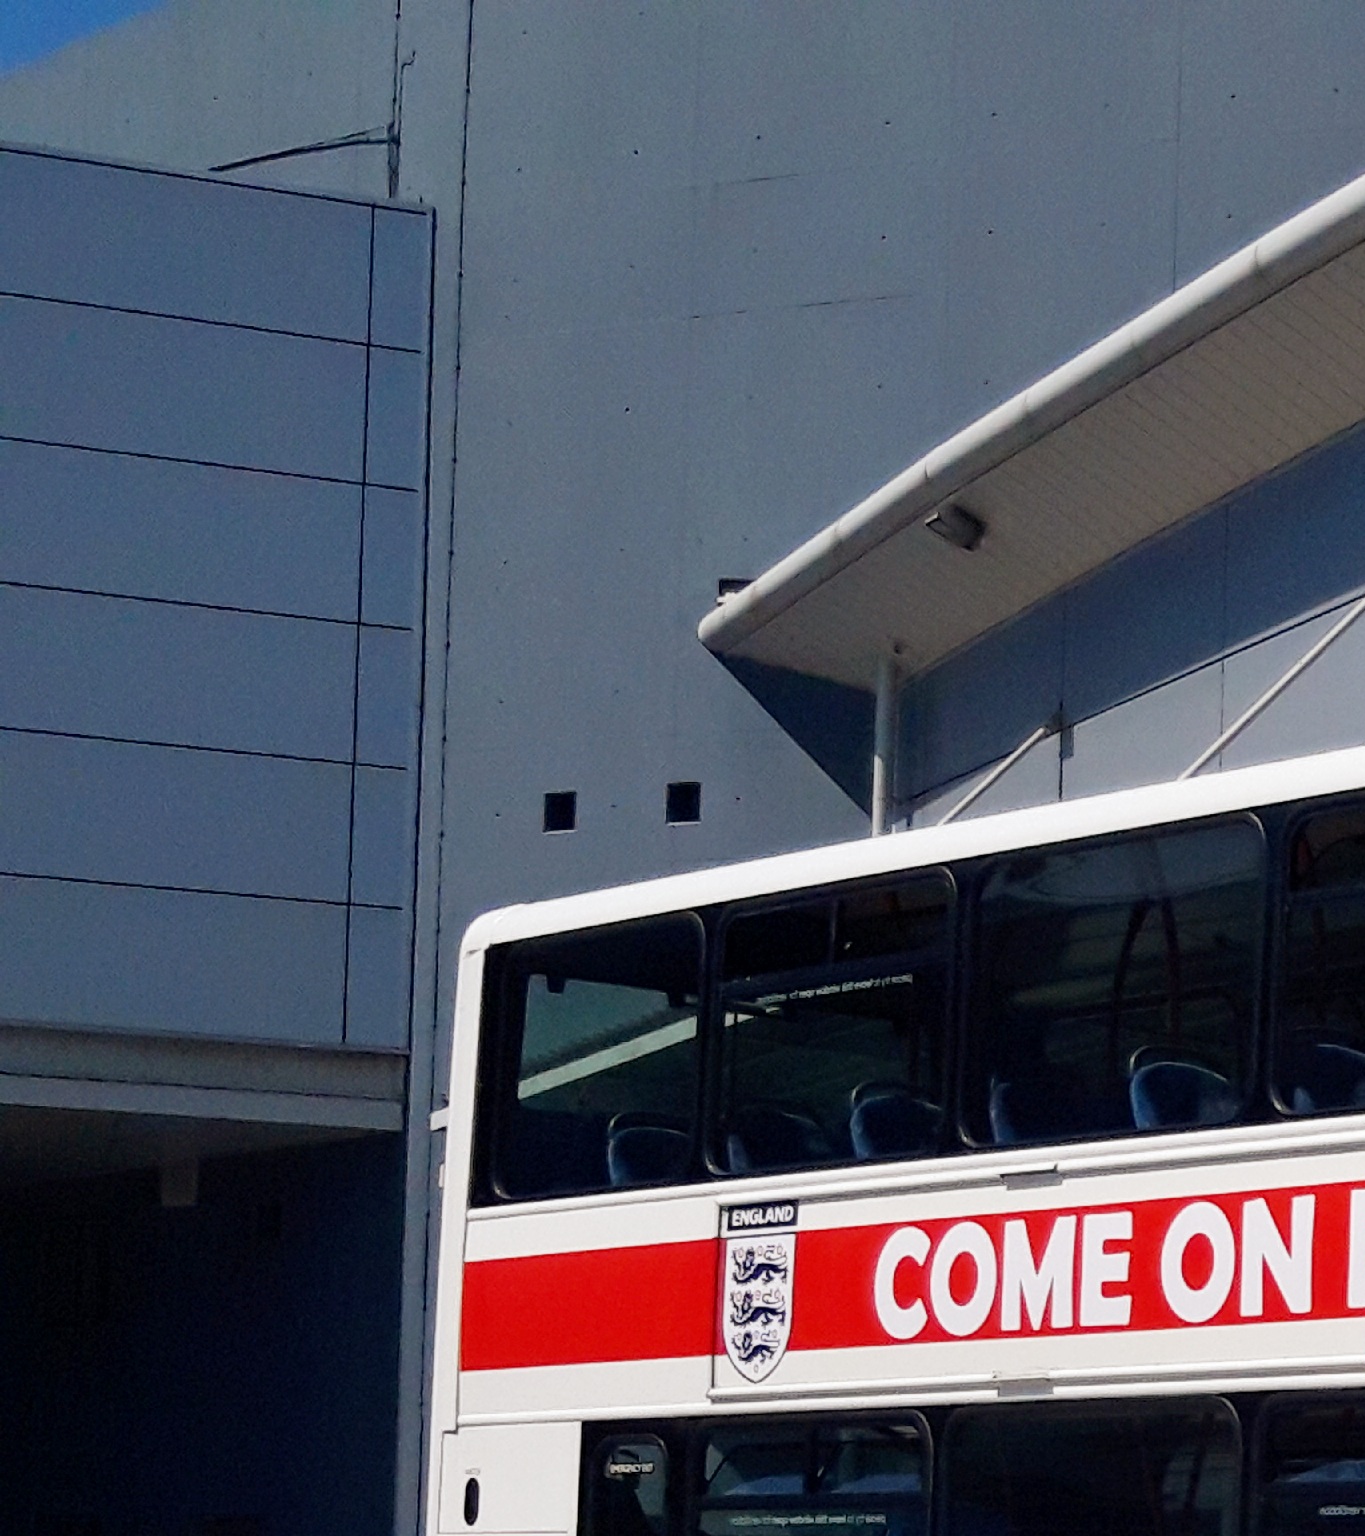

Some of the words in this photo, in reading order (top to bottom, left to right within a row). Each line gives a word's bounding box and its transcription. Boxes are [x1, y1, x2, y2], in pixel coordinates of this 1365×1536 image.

[731, 1204, 795, 1227] ENGLAND
[873, 1209, 1133, 1340] COME
[1160, 1193, 1317, 1324] ON
